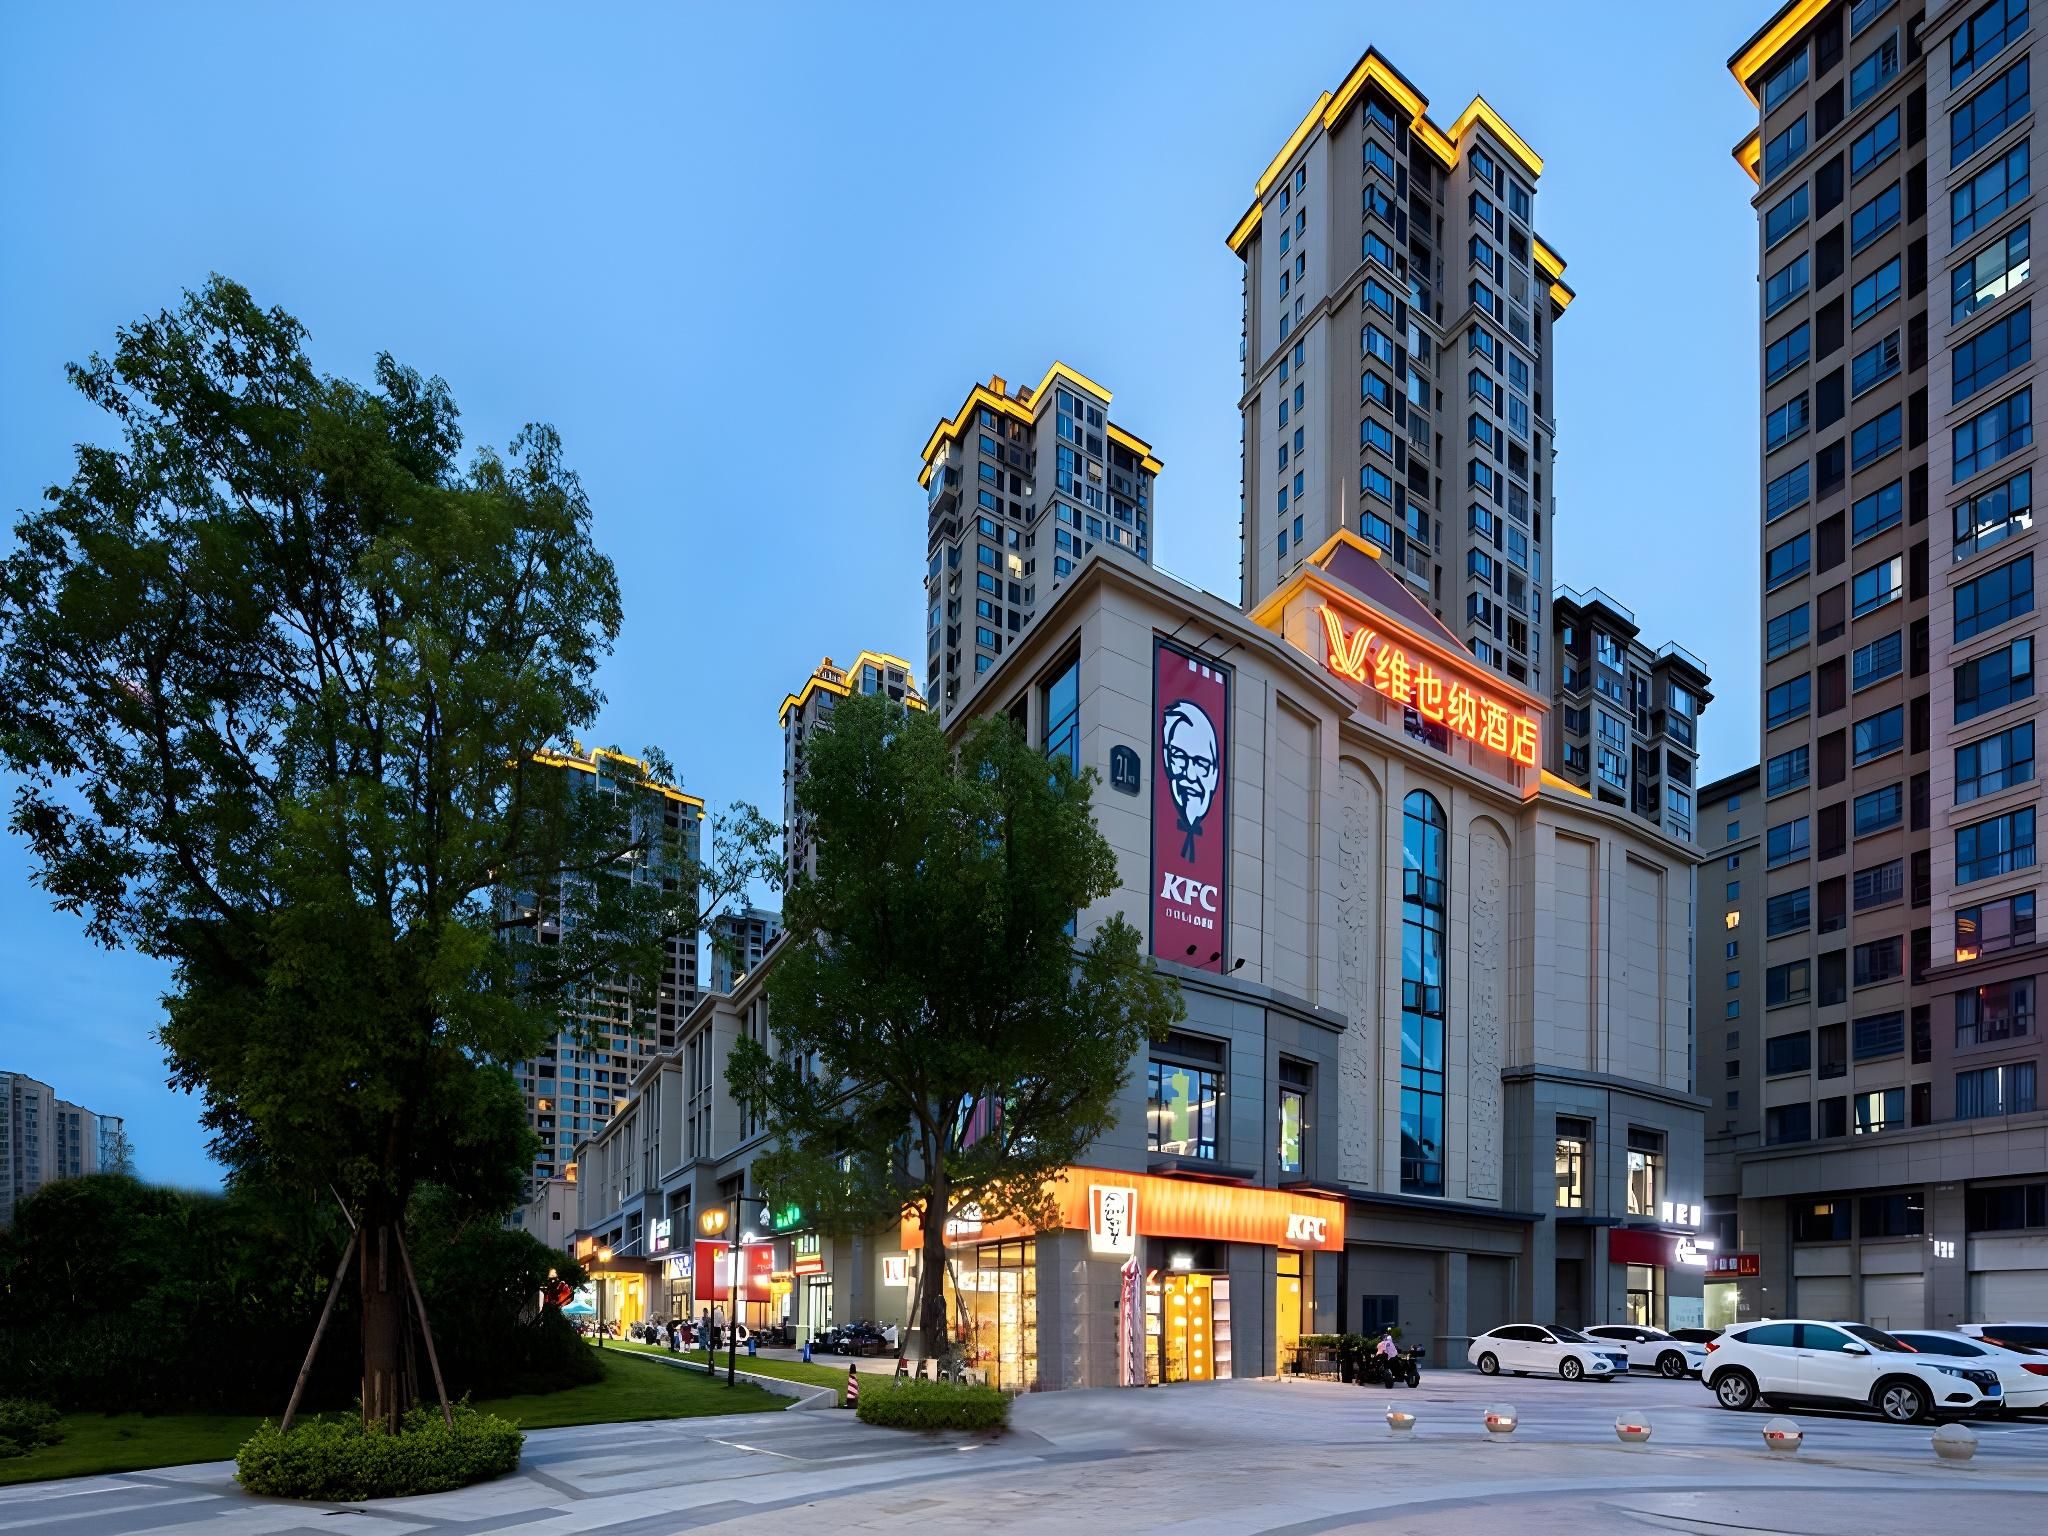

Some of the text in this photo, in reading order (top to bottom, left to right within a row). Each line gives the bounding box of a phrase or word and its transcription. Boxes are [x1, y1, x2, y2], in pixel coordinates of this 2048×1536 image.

[1375, 643, 1538, 766] 维也纳酒店
[1160, 871, 1218, 912] KFC
[1285, 1213, 1327, 1243] KFC
